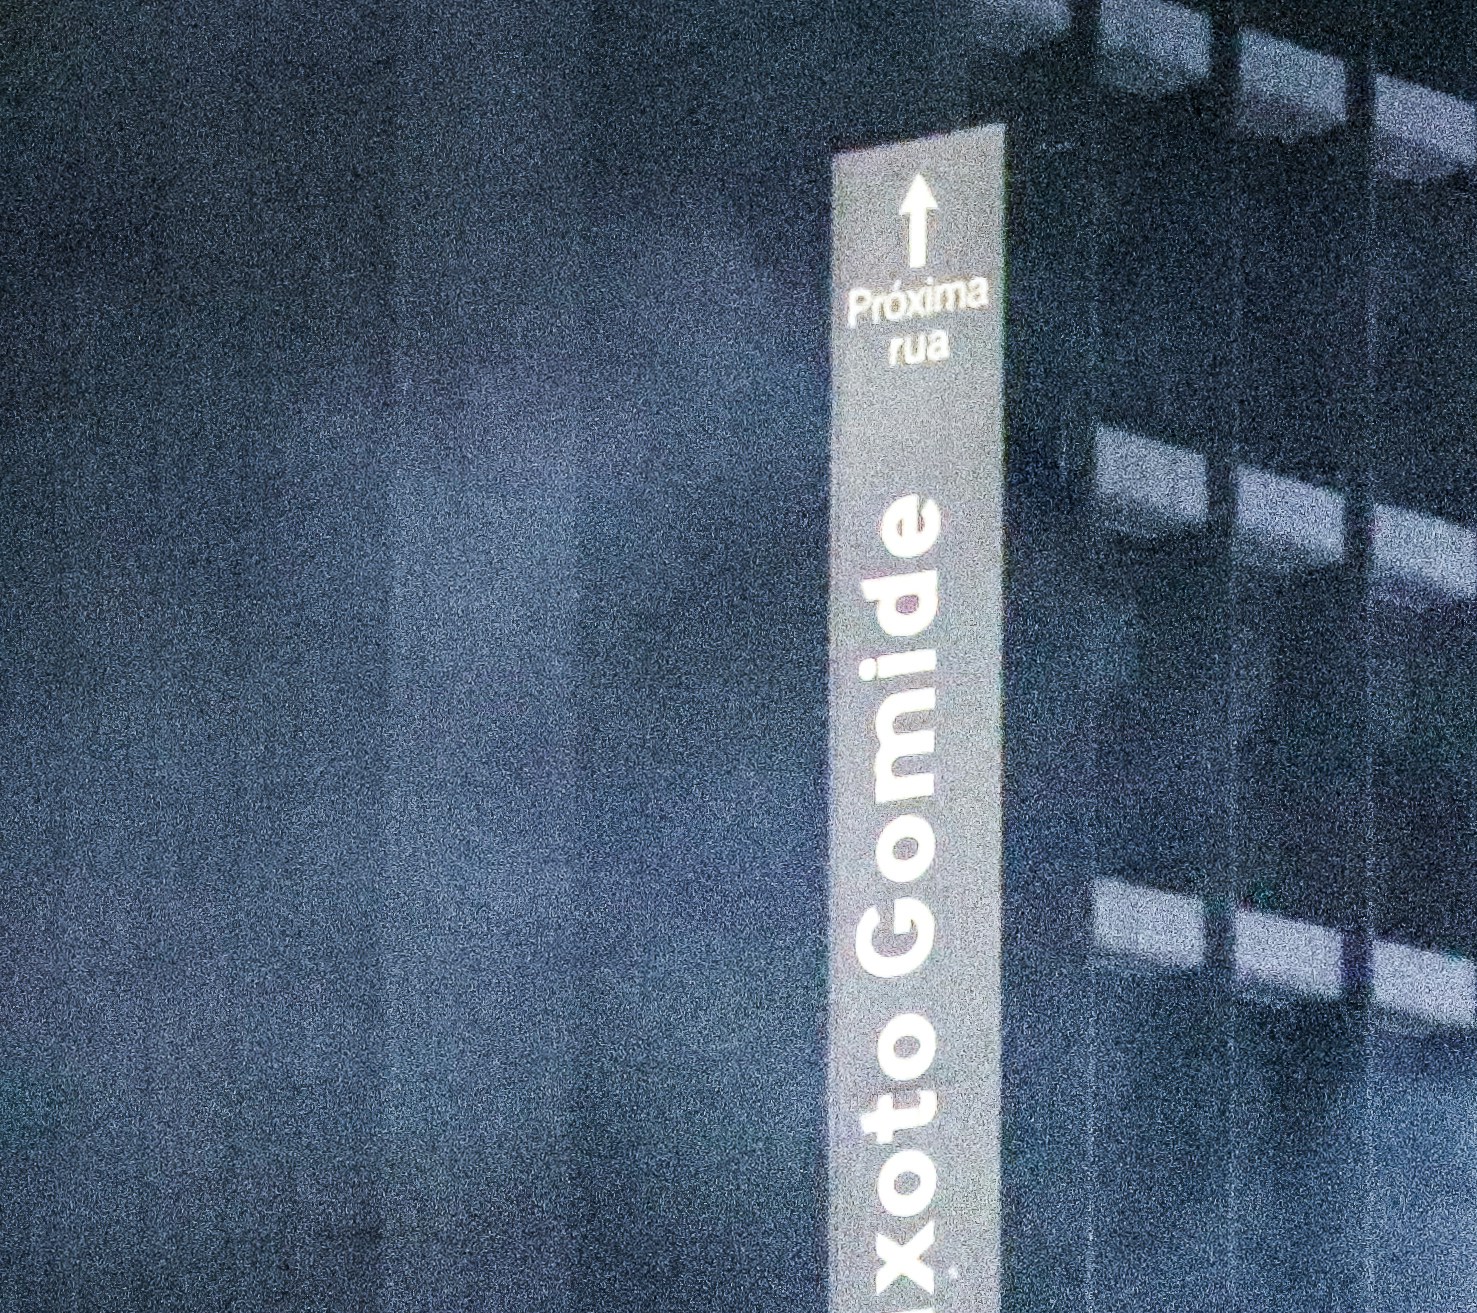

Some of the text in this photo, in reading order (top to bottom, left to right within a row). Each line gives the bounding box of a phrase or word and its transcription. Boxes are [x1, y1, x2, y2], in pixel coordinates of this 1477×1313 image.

[848, 276, 988, 328] Próxima
[889, 328, 950, 367] rua
[855, 494, 942, 979] Gomide
